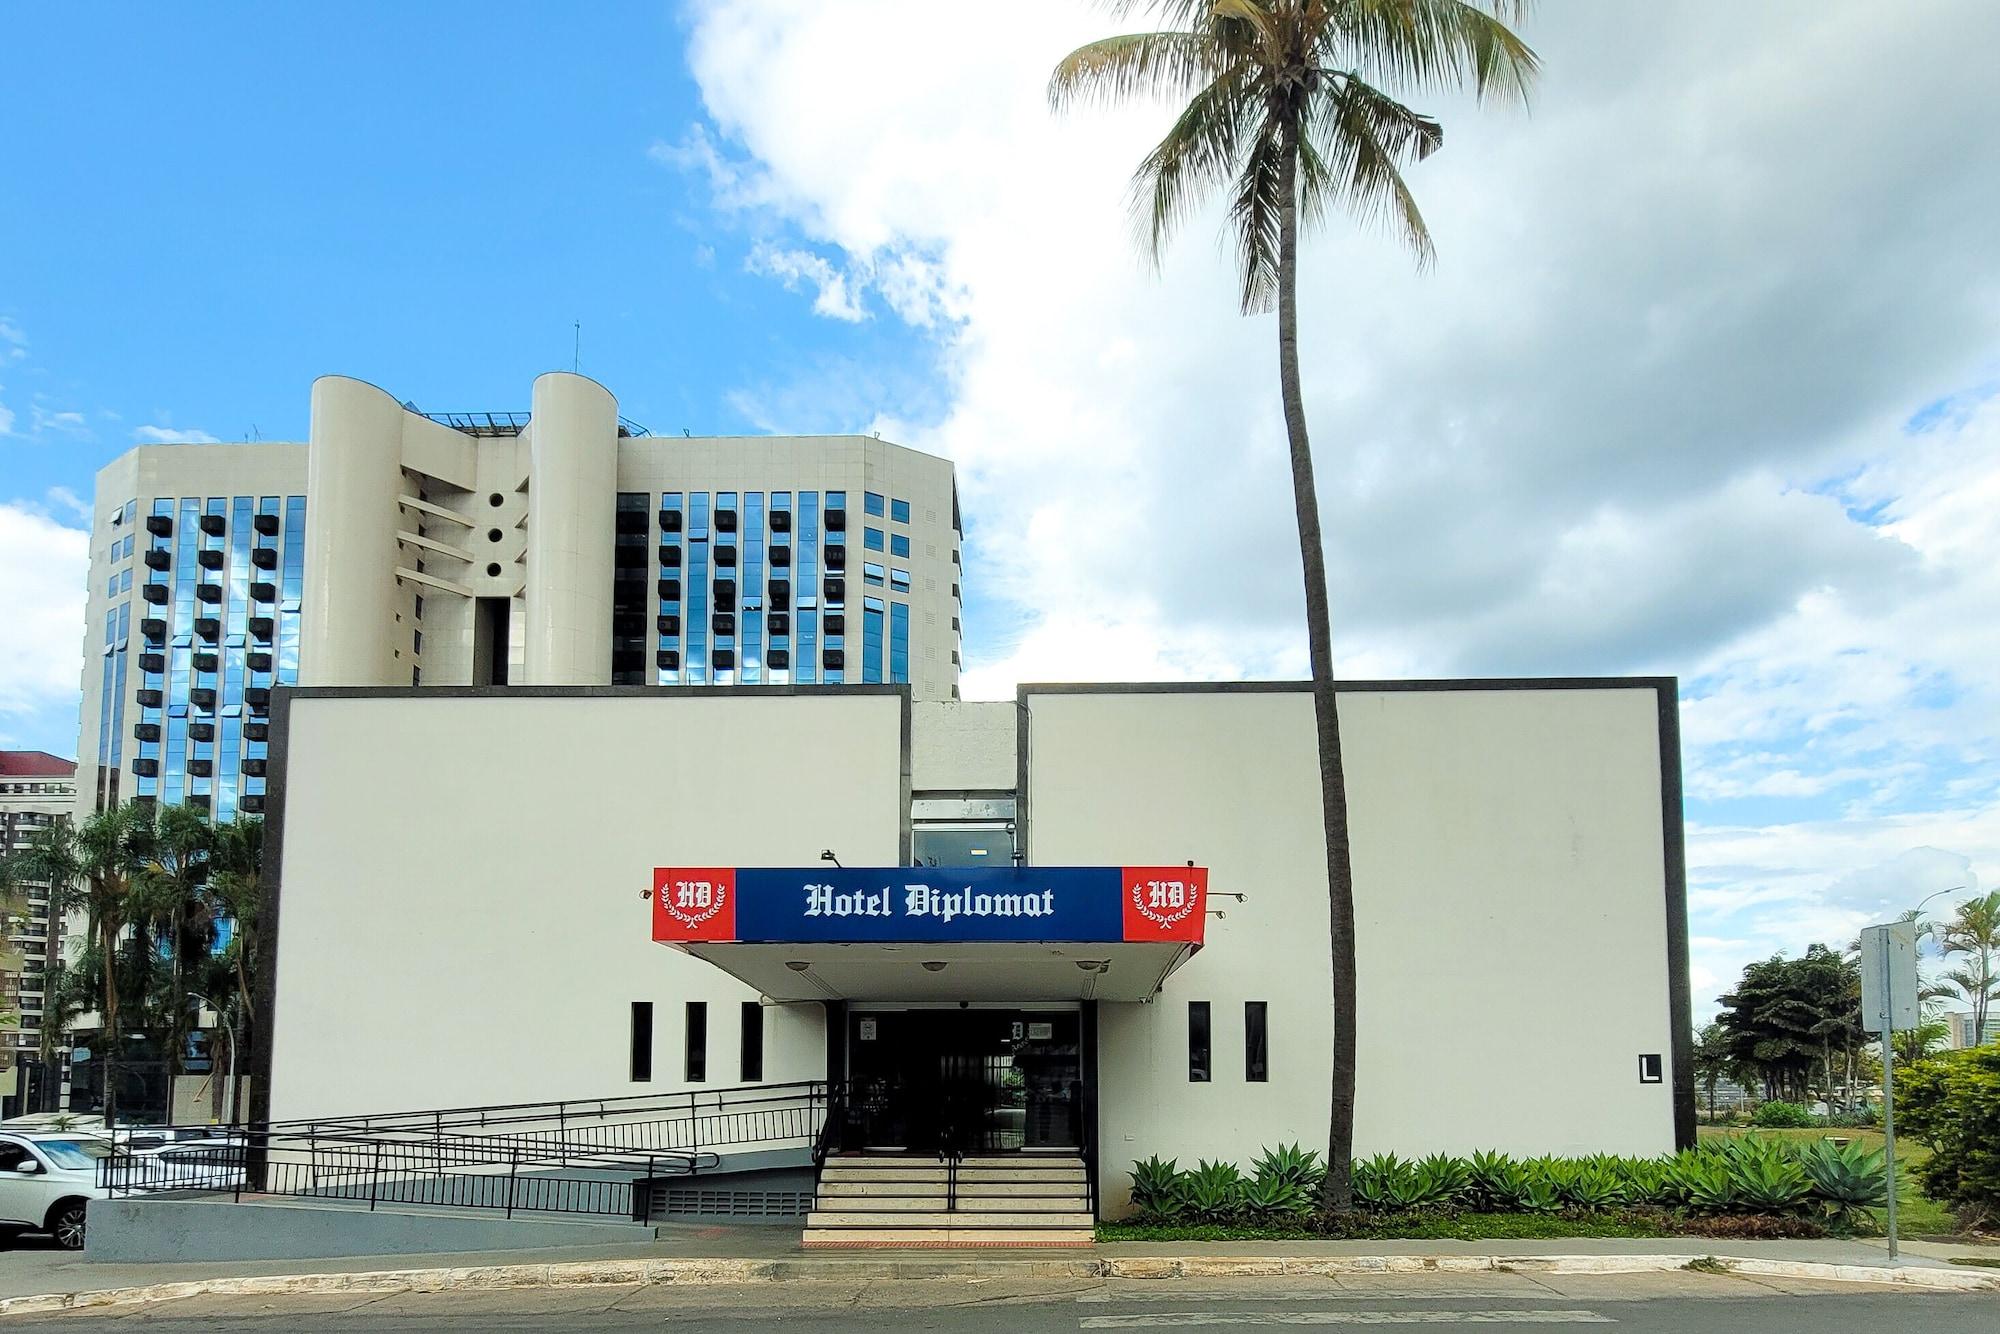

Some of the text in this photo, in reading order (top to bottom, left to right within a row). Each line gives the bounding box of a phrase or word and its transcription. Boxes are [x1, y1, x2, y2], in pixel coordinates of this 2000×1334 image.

[675, 881, 712, 908] HD
[803, 884, 1055, 923] Hotel Diplomat
[1147, 881, 1184, 908] HD
[1642, 1057, 1660, 1081] L
